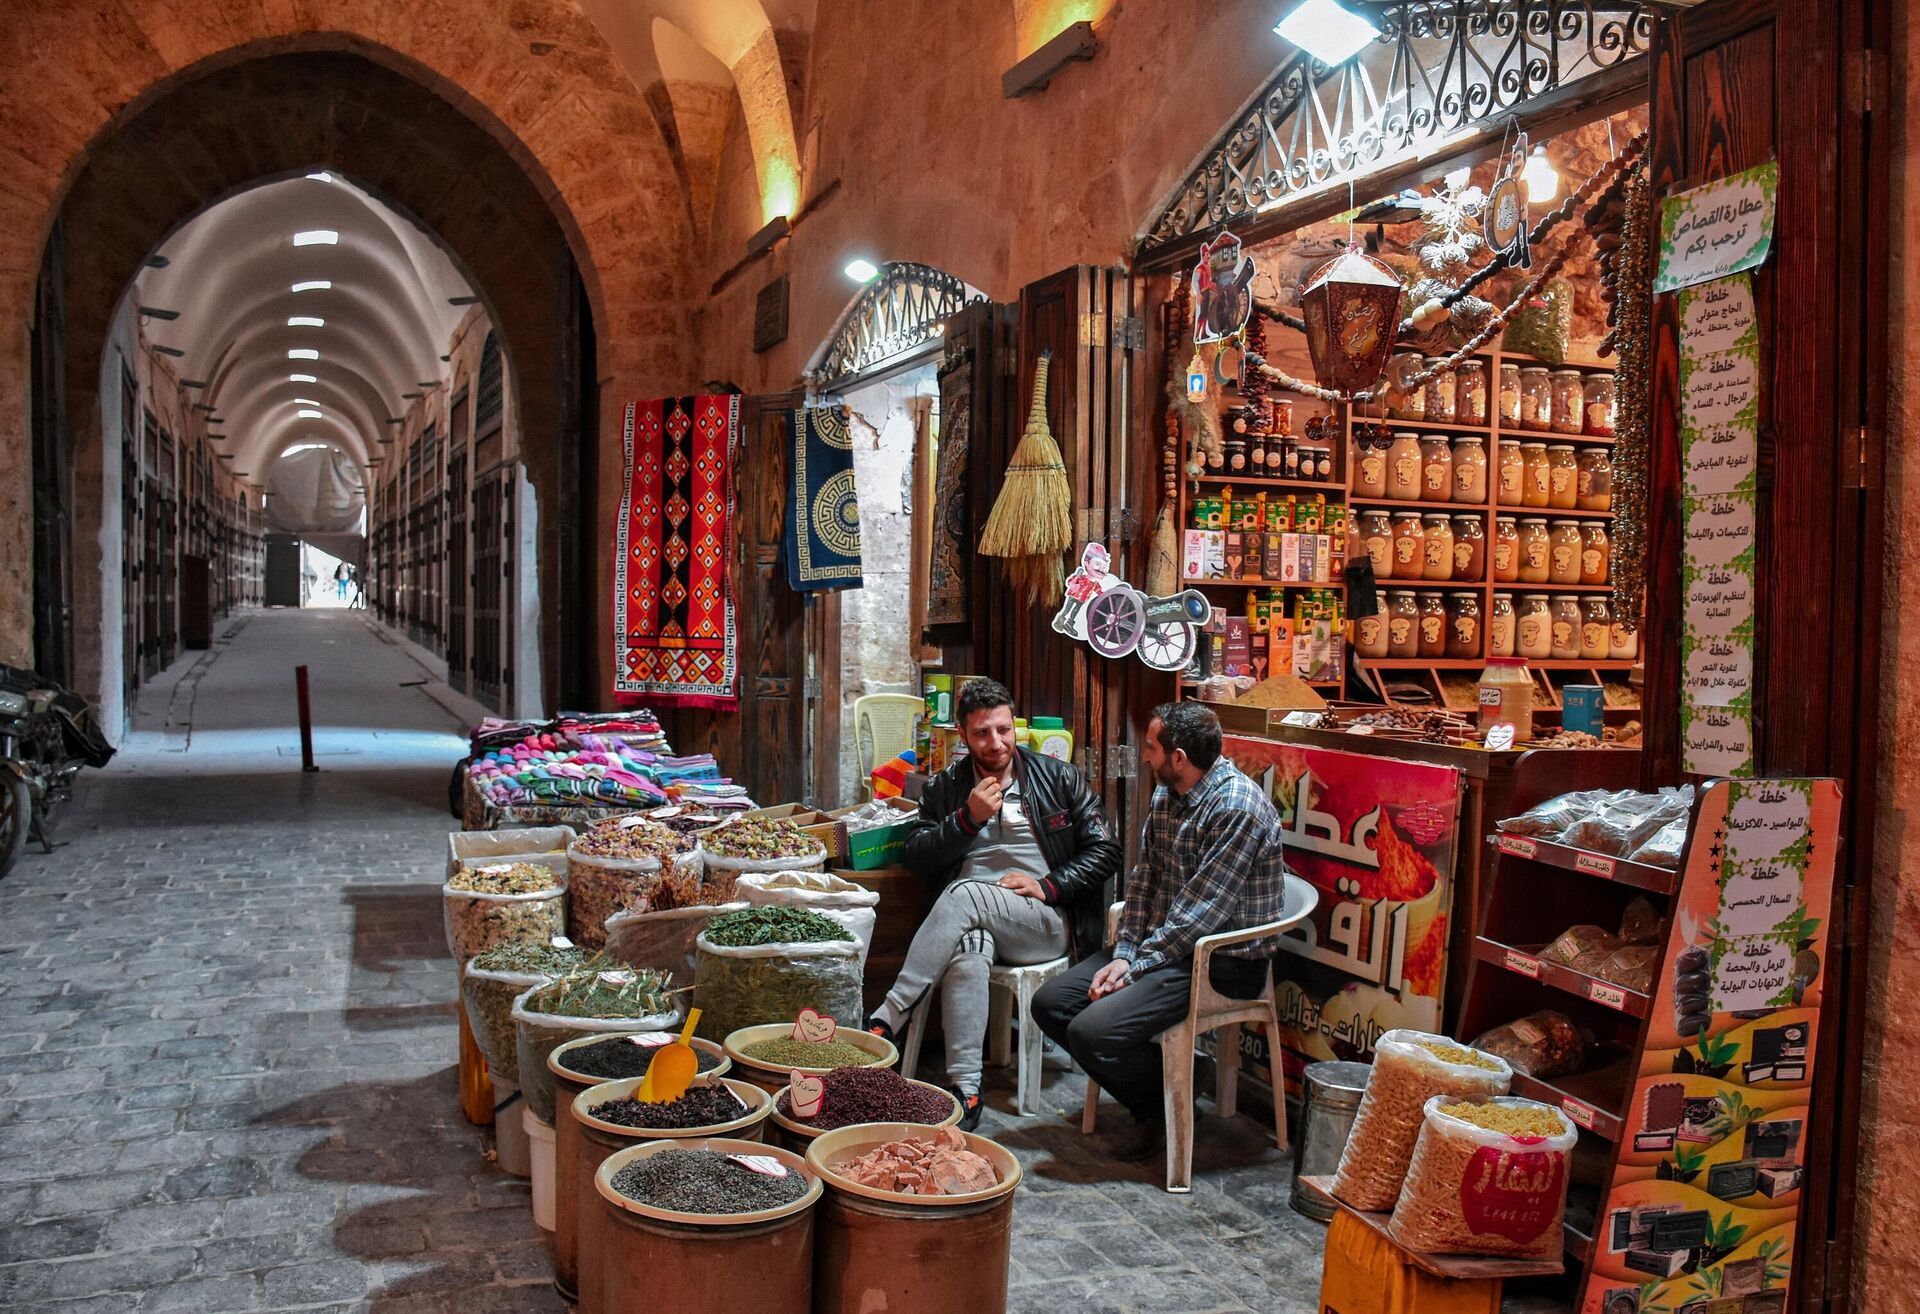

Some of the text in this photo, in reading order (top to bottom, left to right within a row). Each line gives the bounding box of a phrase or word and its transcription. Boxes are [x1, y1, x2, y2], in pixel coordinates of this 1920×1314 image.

[1672, 198, 1763, 241] عطارة القصاص
[1684, 223, 1748, 261] ترحب بكم
[1705, 288, 1729, 303] خلطة
[1696, 301, 1742, 324] الحاج متولي
[1709, 358, 1736, 373] خلطة
[1713, 380, 1724, 392] على
[1692, 397, 1714, 410] للنساء
[1724, 391, 1748, 407] للرجال
[1711, 430, 1736, 444] خلطة
[1692, 454, 1749, 471] لتقوية المبايض
[1710, 502, 1736, 515] خلطة
[1716, 526, 1749, 539] للتكيسات
[1707, 572, 1732, 585] خلطة
[1690, 590, 1746, 604] لتنظيم الهرمونات
[1709, 643, 1734, 656] خلطة
[1700, 663, 1718, 673] الشعر
[1700, 678, 1709, 687] 10
[1706, 714, 1731, 727] خلطة
[1690, 738, 1745, 754] للقلب والشرايين
[1758, 790, 1787, 803] خلطة
[1733, 818, 1763, 831] للاكزيما
[1769, 817, 1804, 830] للبواسير
[1750, 866, 1779, 880] خلطة
[1728, 893, 1792, 911] للسعال التحسسي
[1743, 943, 1772, 957] خلطة
[1725, 958, 1786, 974] للرمل والبحصة
[1720, 979, 1747, 994] البولية
